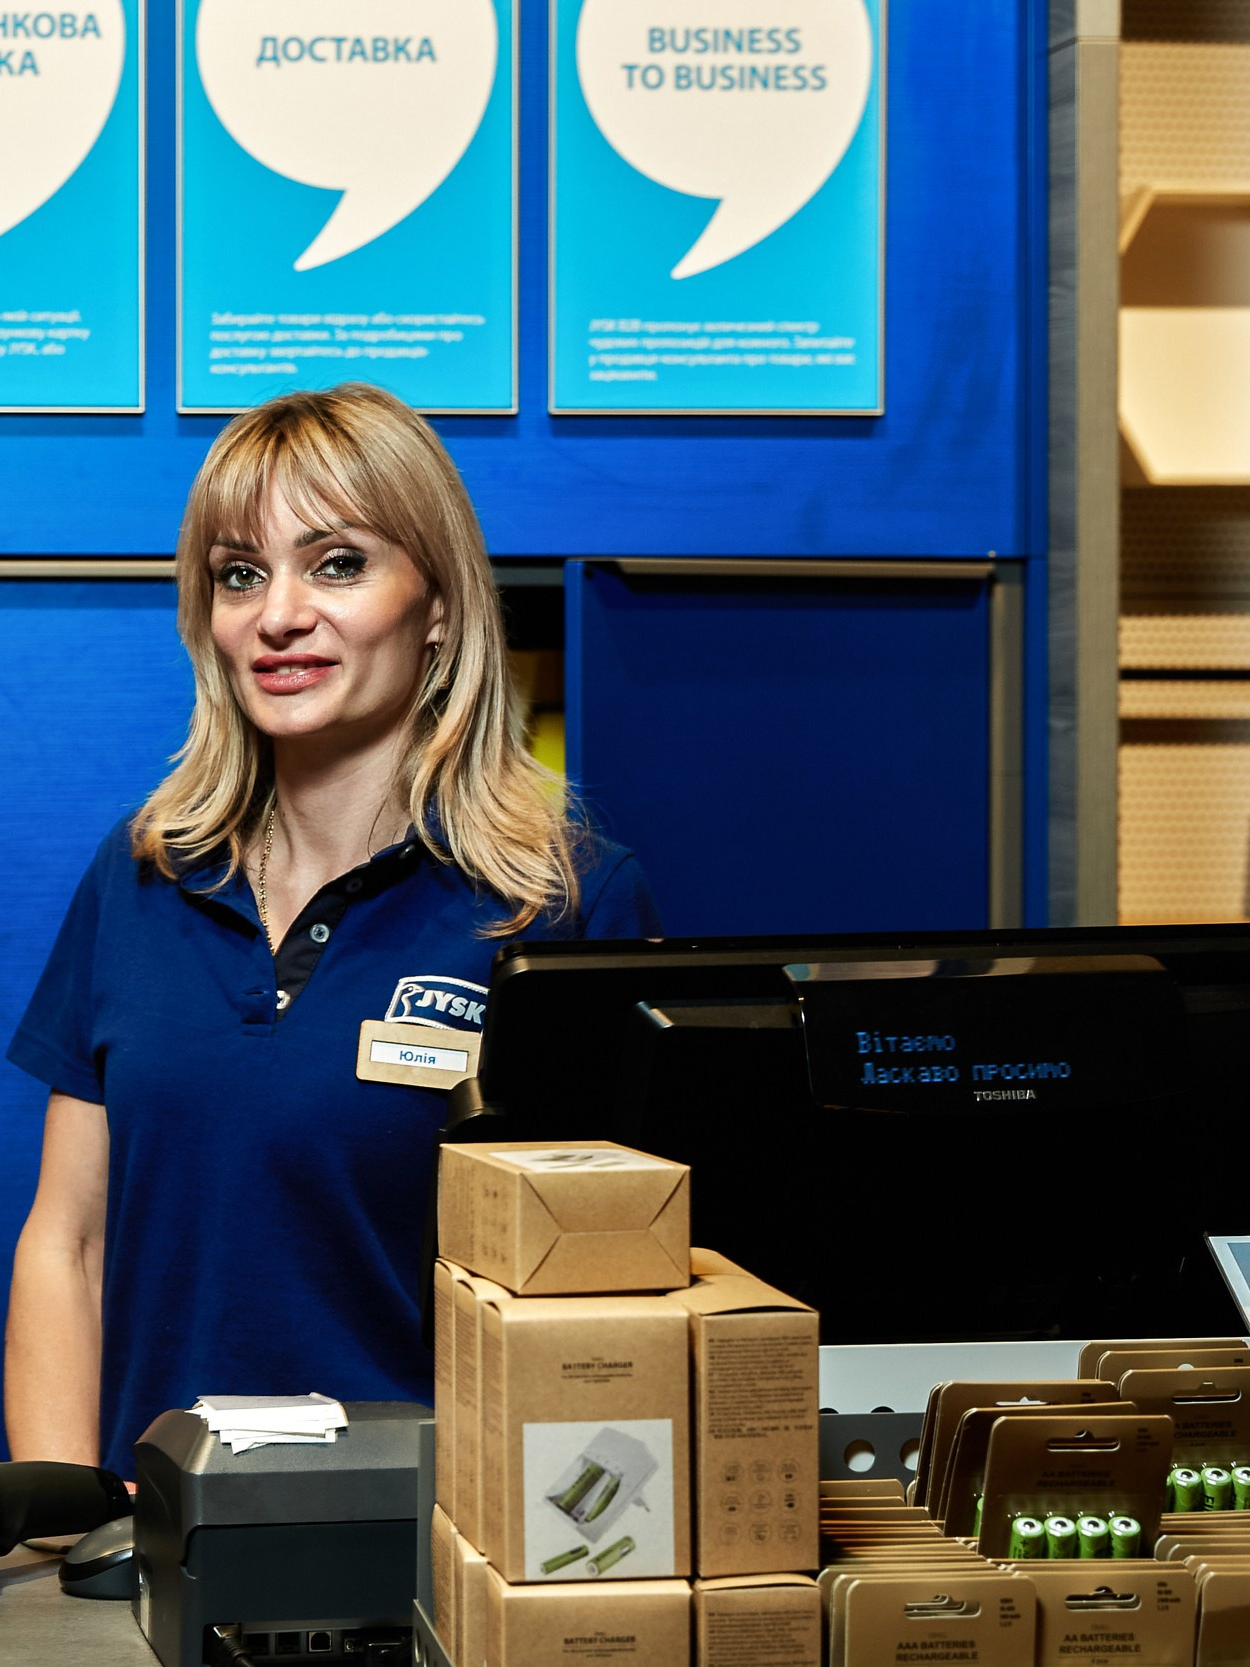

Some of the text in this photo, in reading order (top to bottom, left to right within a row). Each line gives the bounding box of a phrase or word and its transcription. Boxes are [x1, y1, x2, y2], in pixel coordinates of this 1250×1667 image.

[648, 27, 802, 53] BUSINESS
[256, 37, 437, 69] ДОСТАВКА
[622, 64, 827, 91] TO BUSINESS
[415, 989, 487, 1024] JYSK
[856, 1031, 956, 1053] Вітаємо
[399, 1050, 436, 1065] Юлія
[860, 1062, 960, 1084] Ласкаво
[973, 1089, 1036, 1101] TOSHIBA
[897, 1640, 975, 1650] AAA BATTERIES
[1063, 1632, 1135, 1642] AA BATTERIES
[895, 1652, 978, 1661] RECHARGEABLE
[1059, 1644, 1141, 1654] RECHARGEABLE
